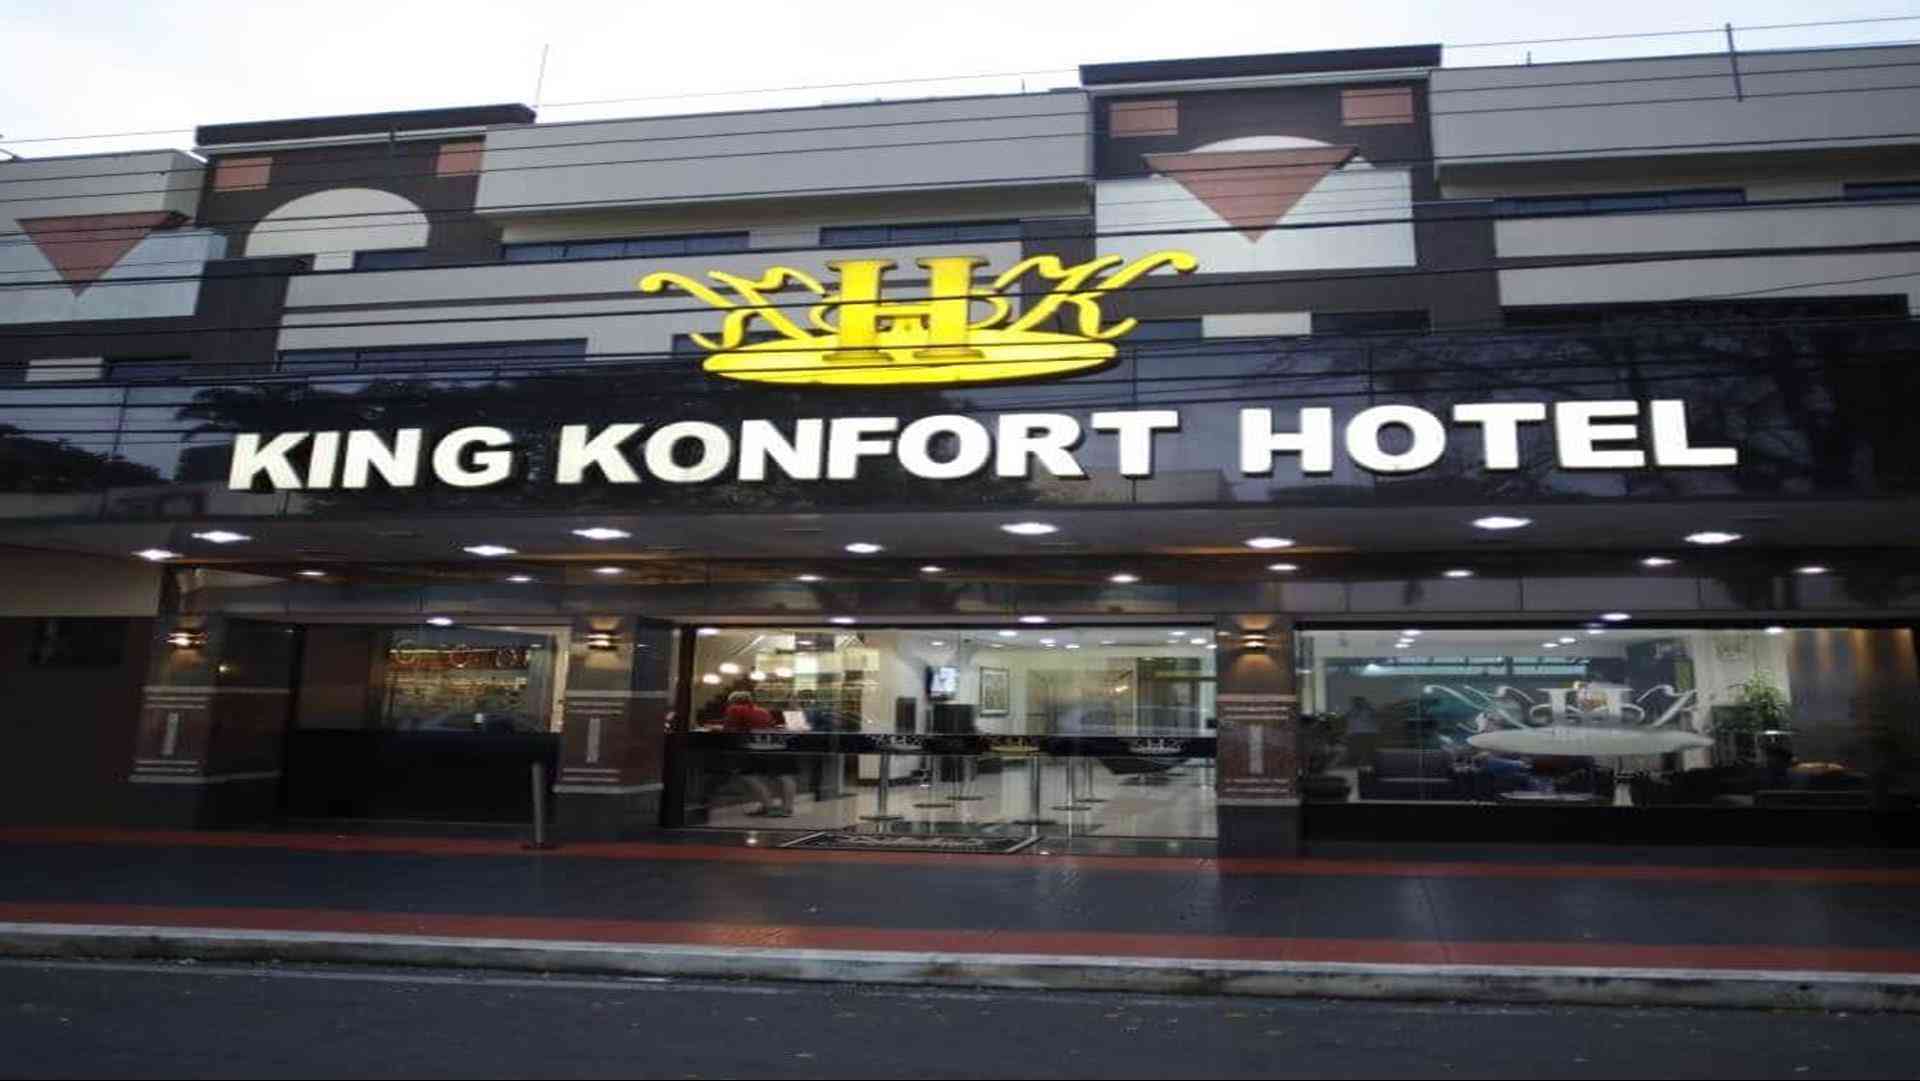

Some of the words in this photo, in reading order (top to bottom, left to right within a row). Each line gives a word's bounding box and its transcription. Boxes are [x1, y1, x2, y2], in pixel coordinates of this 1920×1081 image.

[228, 426, 513, 492] KING
[556, 410, 1180, 486] KONFORT
[1239, 398, 1739, 475] HOTEL
